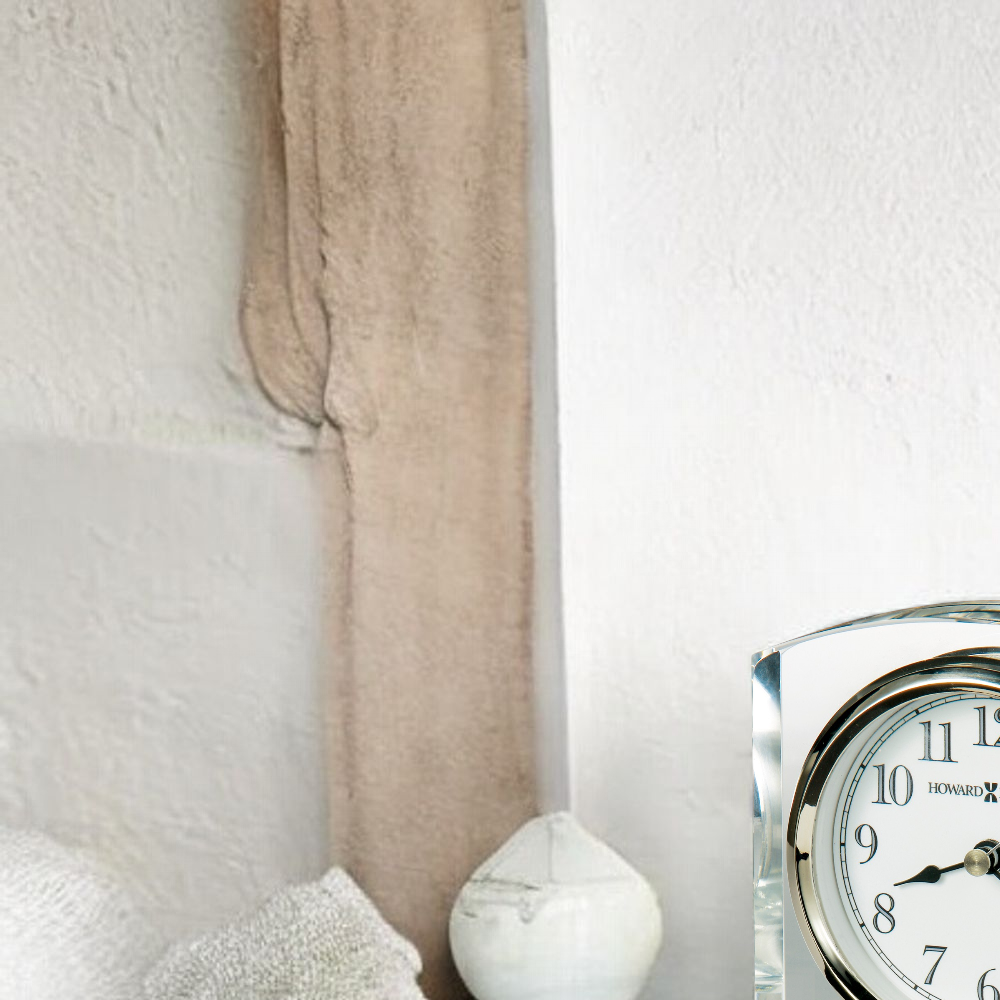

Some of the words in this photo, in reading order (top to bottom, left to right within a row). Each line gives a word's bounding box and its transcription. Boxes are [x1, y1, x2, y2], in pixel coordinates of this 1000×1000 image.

[918, 720, 958, 763] 11
[873, 763, 913, 806] 10
[928, 782, 984, 797] HOWARD
[855, 824, 878, 864] 9
[872, 893, 896, 934] 8
[923, 945, 948, 985] 7
